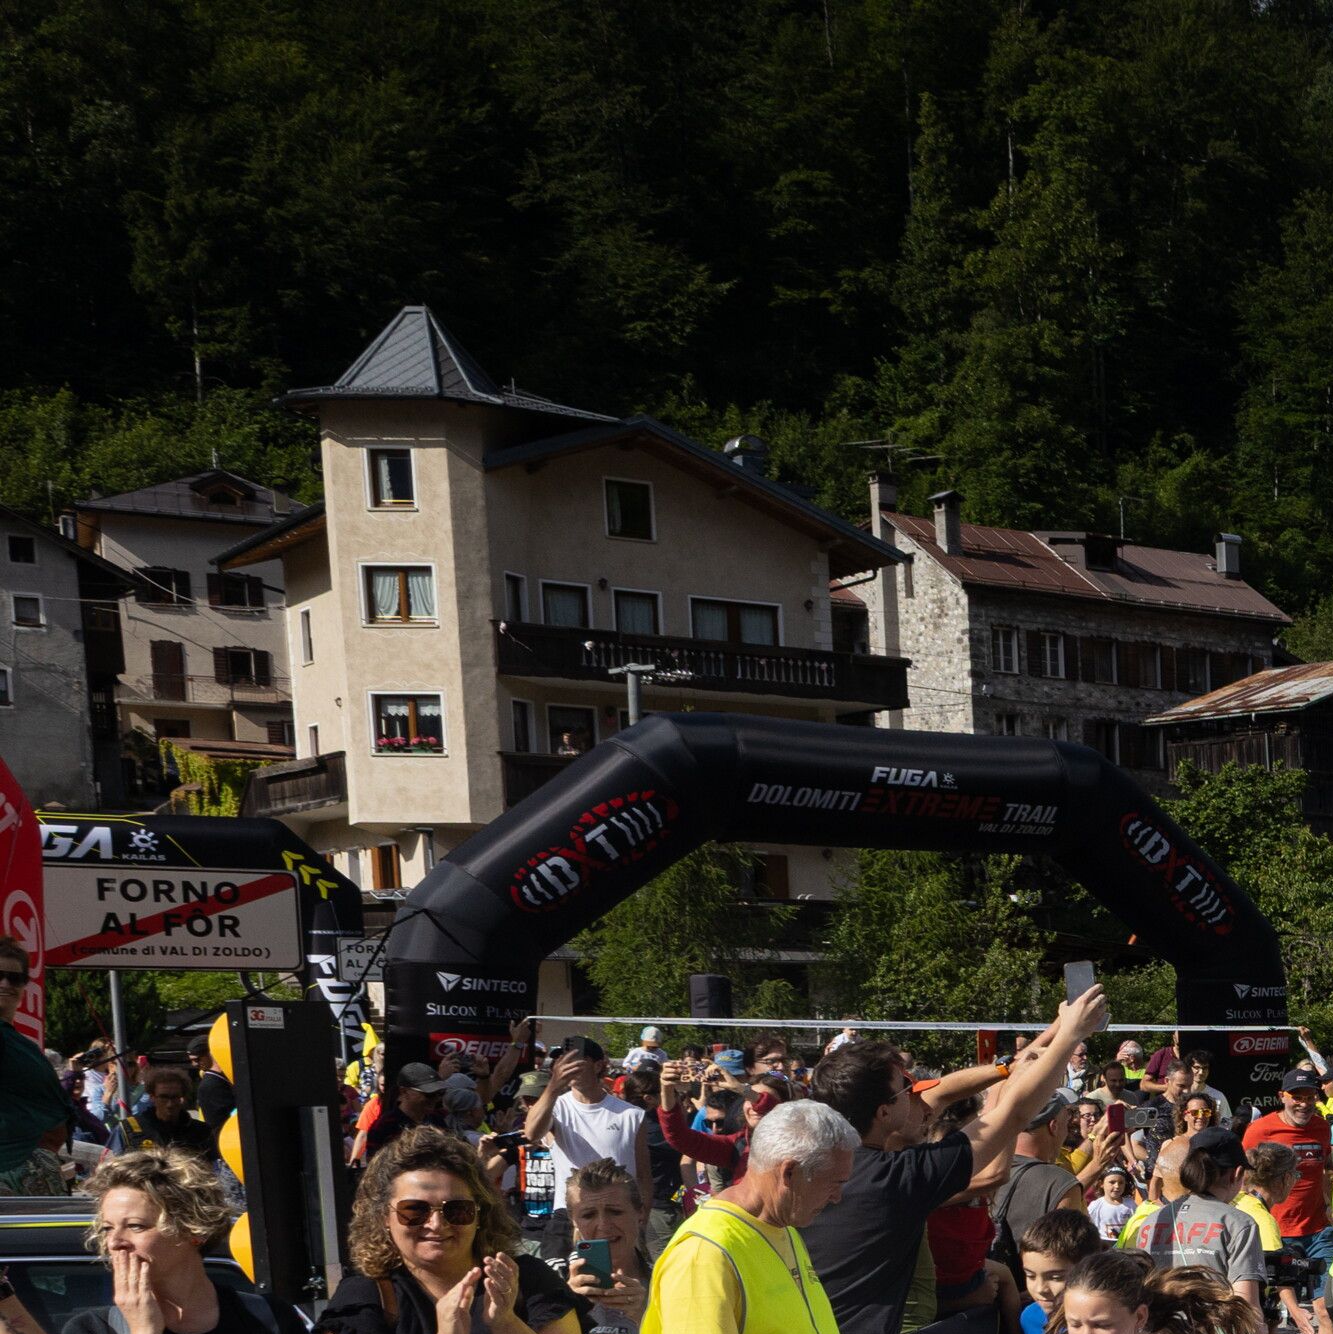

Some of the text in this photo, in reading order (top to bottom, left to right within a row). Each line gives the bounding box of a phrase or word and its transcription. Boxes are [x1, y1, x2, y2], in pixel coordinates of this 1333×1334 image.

[870, 766, 938, 788] FUGA
[749, 782, 1058, 824] DOLOMITI EXTREME TRAIL
[978, 822, 1054, 836] VAL DI ZOLDO
[39, 824, 114, 860] GA
[121, 853, 167, 862] KAILAS
[97, 877, 241, 904] FORNO
[100, 908, 242, 938] AL FÔR
[72, 945, 271, 960] (comune di VAL DI ZOLDO)
[346, 945, 387, 954] FORN
[461, 977, 527, 993] SINTECO
[426, 1002, 478, 1017] SILCON
[1267, 1009, 1287, 1019] PLAS
[1250, 1062, 1287, 1083] Ford
[1240, 1096, 1283, 1108] GARM
[1139, 1222, 1225, 1249] STAFF
